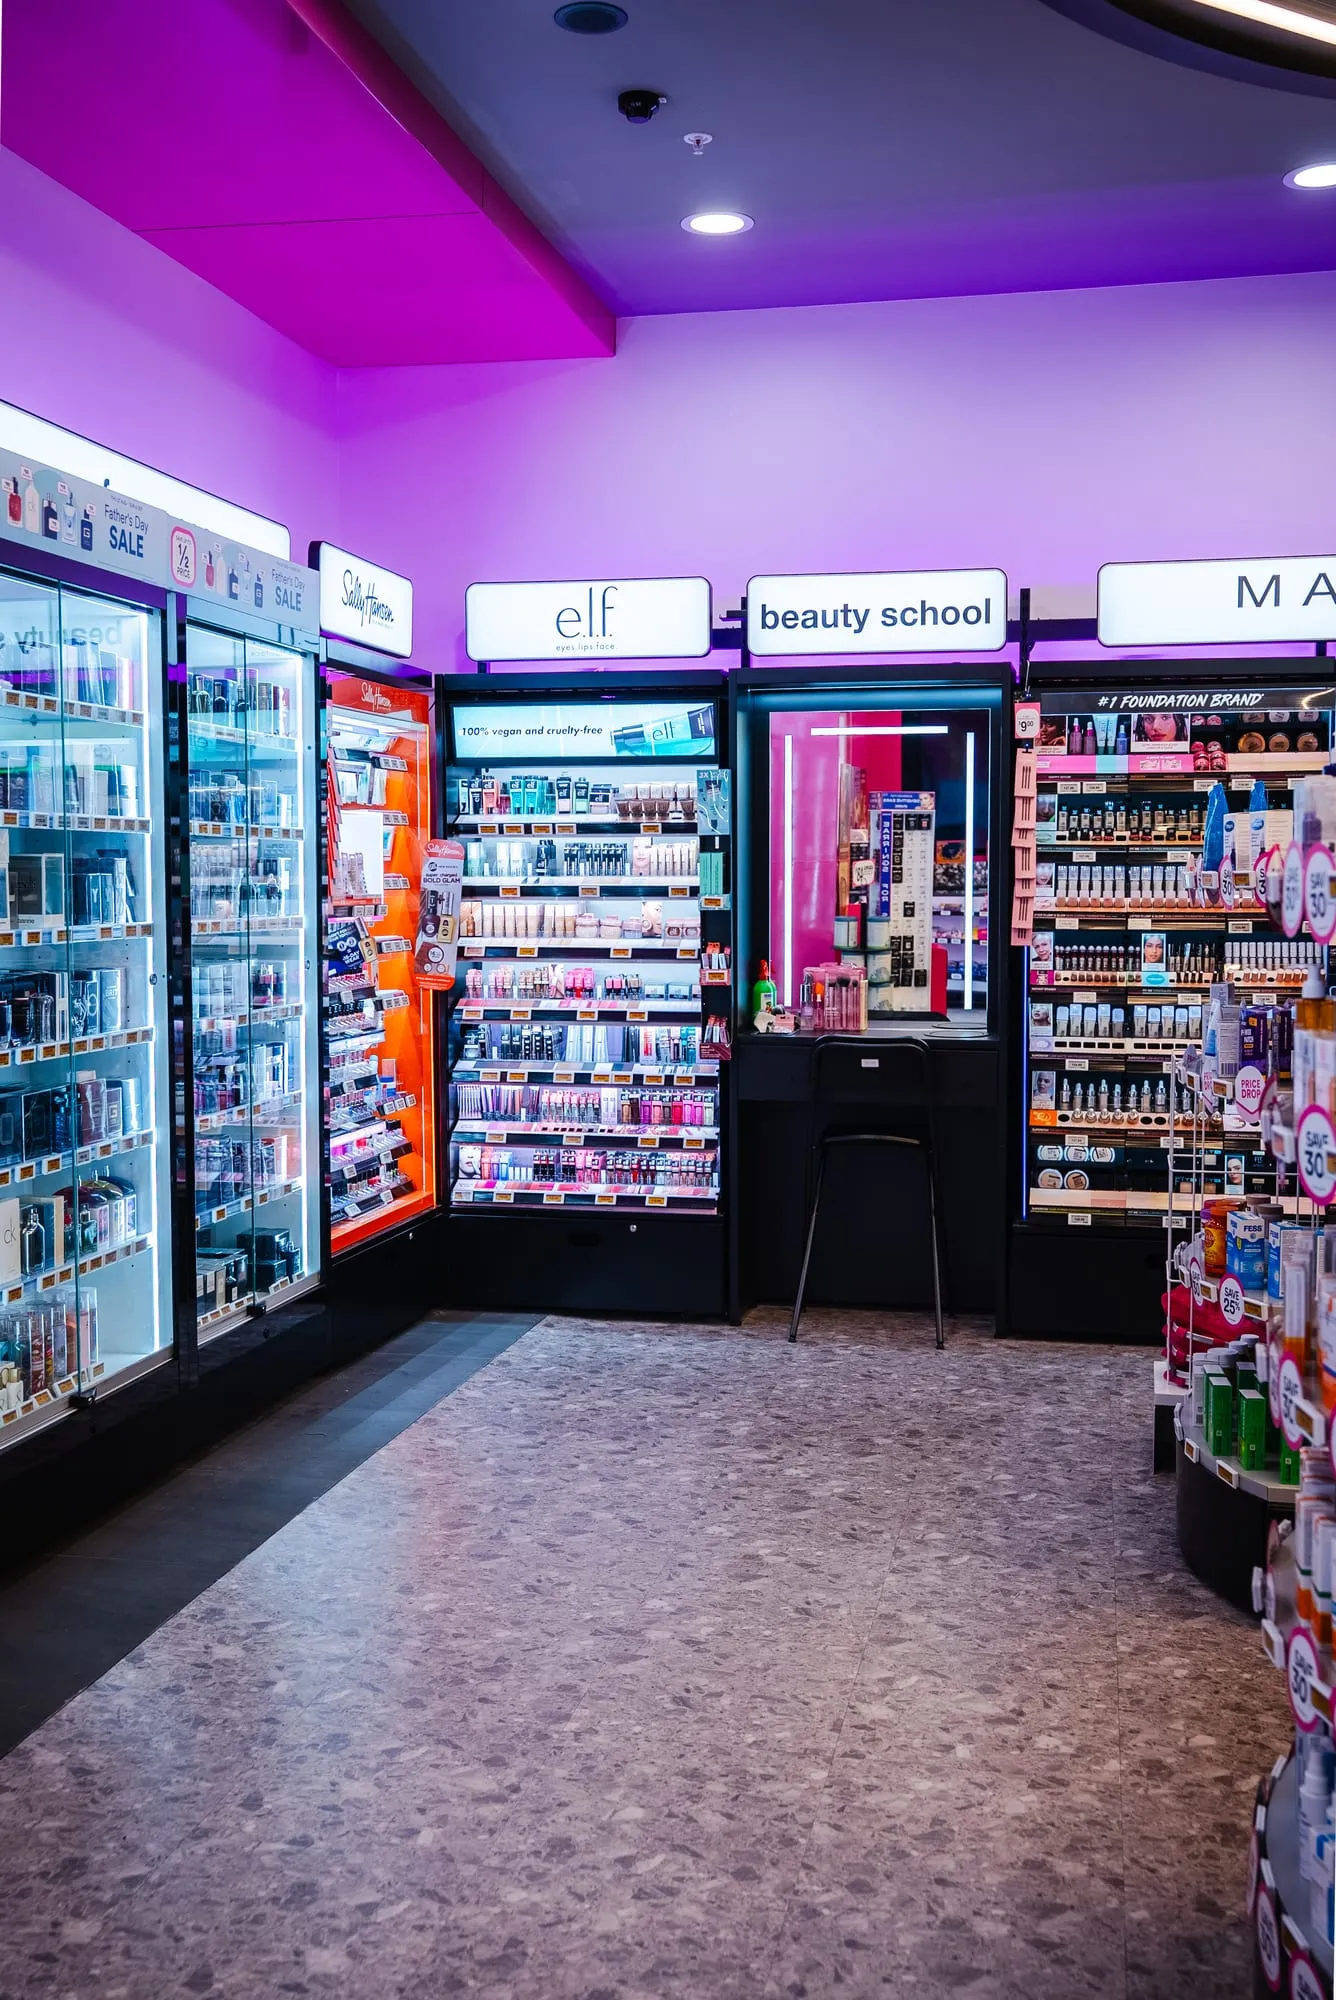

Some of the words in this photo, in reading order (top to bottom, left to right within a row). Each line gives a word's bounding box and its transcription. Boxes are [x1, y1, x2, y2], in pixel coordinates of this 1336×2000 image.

[104, 504, 133, 528] Father's
[134, 515, 148, 535] Day
[109, 525, 144, 558] SALE
[176, 566, 190, 579] PRICE
[275, 586, 302, 612] SALE
[342, 569, 365, 627] Sally
[761, 604, 870, 634] beauty
[881, 598, 991, 626] school
[1098, 696, 1118, 708] #1
[1120, 694, 1208, 710] FOUNDATION
[462, 727, 488, 736] 100%
[492, 730, 522, 738] vegan
[525, 726, 544, 735] and
[547, 725, 603, 736] cruelty-free
[1222, 880, 1232, 896] 30
[1310, 892, 1326, 918] 30
[1240, 1080, 1260, 1088] PRICE
[1241, 1089, 1262, 1098] DROP
[1306, 1131, 1328, 1149] SAVE
[1306, 1150, 1324, 1178] 30
[4, 1216, 16, 1245] ck
[1244, 1224, 1263, 1232] FESS
[1224, 1286, 1240, 1300] SAVE
[1224, 1298, 1240, 1315] 25%
[1292, 1666, 1308, 1704] 30
